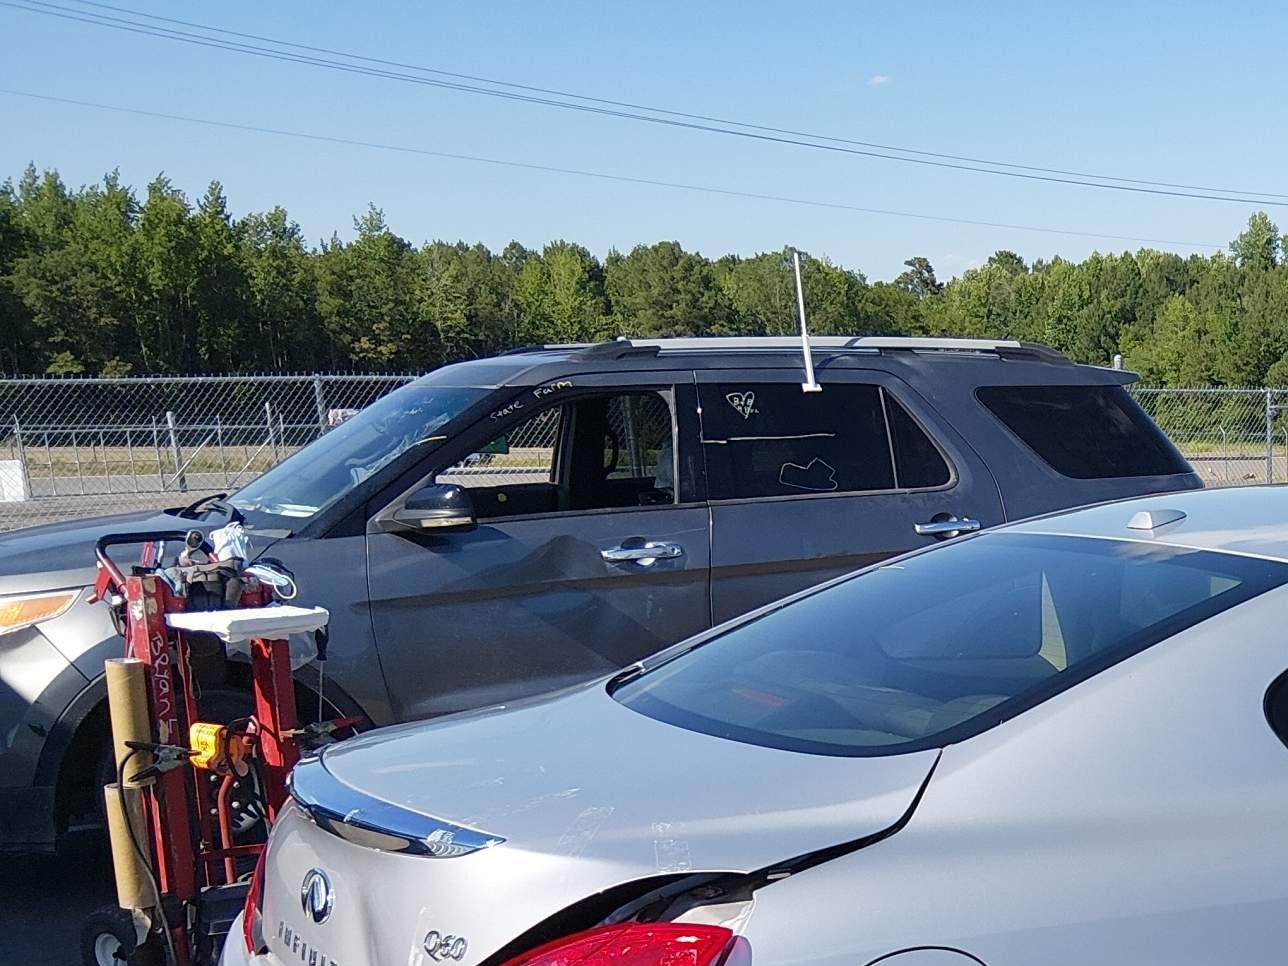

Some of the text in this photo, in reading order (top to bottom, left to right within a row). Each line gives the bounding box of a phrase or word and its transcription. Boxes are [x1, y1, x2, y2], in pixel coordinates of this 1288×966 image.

[490, 380, 573, 422] State Farm
[424, 930, 468, 962] Q60
